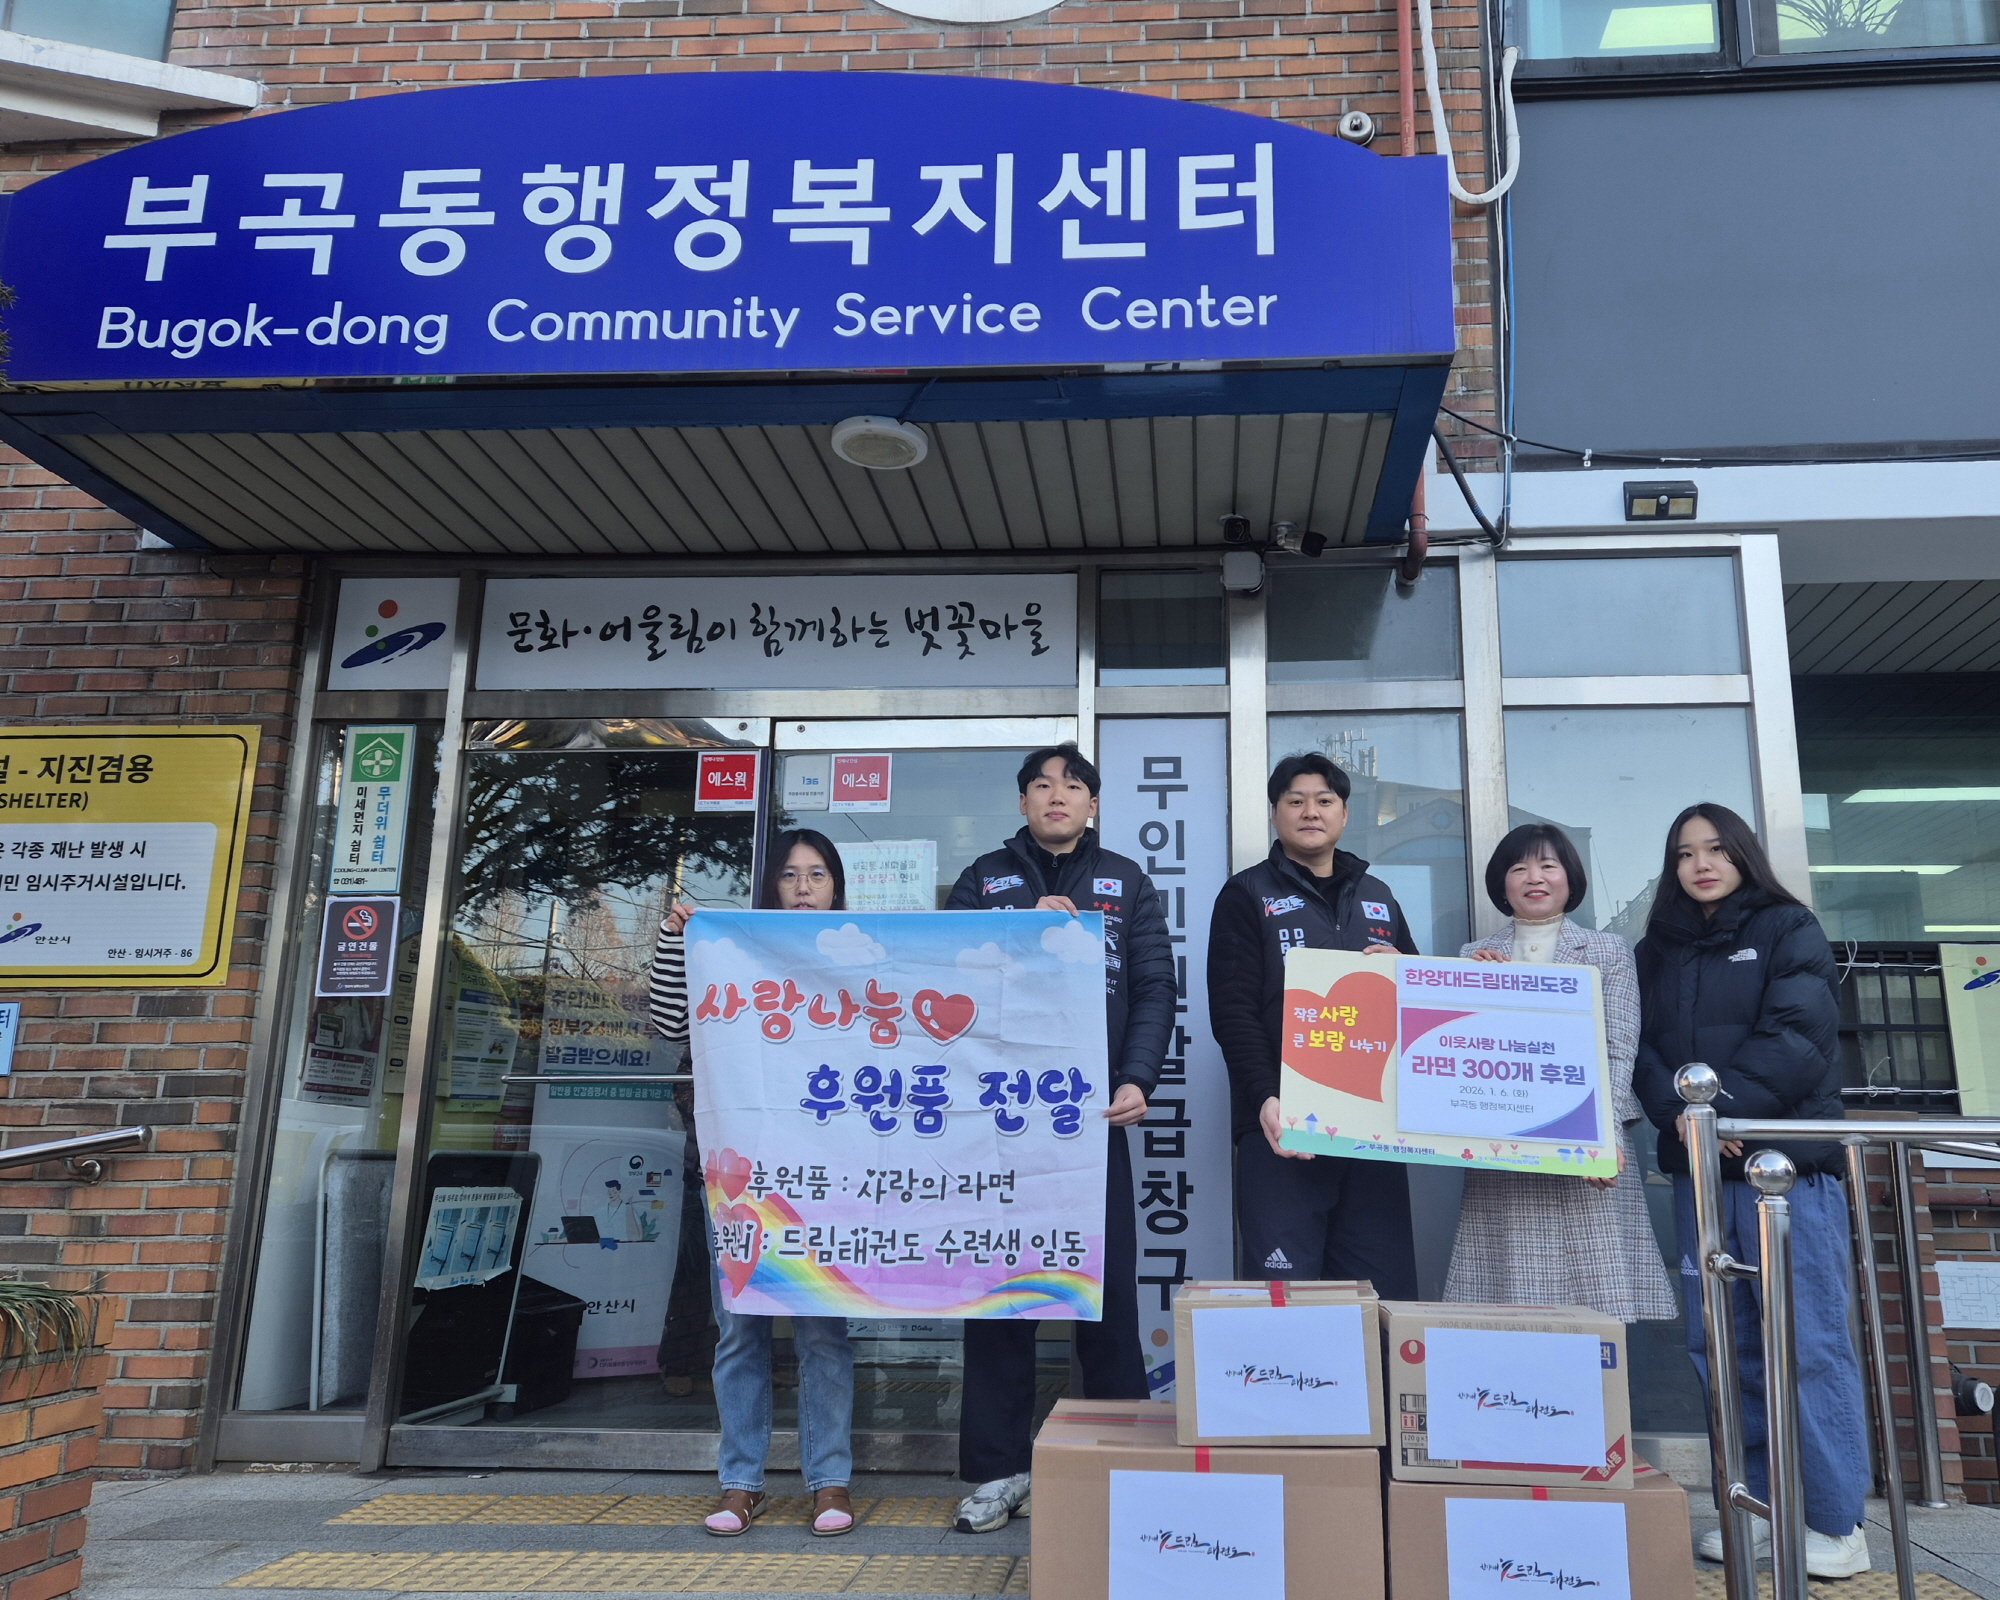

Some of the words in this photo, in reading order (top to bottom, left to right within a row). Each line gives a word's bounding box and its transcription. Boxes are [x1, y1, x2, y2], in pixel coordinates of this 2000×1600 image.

[103, 143, 1275, 281] 부곡동행정복지센터
[97, 301, 449, 359] Bugok-dong
[487, 296, 800, 348] Community
[833, 292, 1041, 338] Service
[1081, 285, 1278, 332] Center
[750, 602, 890, 657] 함께하는
[37, 754, 154, 784] 지진겸용
[708, 771, 747, 787] 에스원
[842, 773, 880, 788] 에스원
[352, 786, 367, 836] 미세먼지
[374, 786, 391, 831] 무더위
[11, 840, 44, 859] 각종
[50, 841, 84, 859] 재난
[91, 841, 124, 858] 발생
[130, 841, 146, 858] 시
[349, 840, 361, 865] 쉼터
[371, 835, 386, 865] 쉼터
[26, 873, 186, 892] 임시주거시설입니다.
[35, 936, 71, 945] 안산시
[337, 942, 378, 952] 금연건물
[108, 949, 126, 959] 안산
[135, 949, 172, 959] 임시거주
[180, 949, 192, 958] 86
[1405, 968, 1578, 994] 한양대드림태권도장
[696, 978, 903, 1050] 사랑나눔
[1293, 1006, 1318, 1023] 작은
[1319, 1006, 1358, 1028] 사랑
[1292, 1032, 1305, 1049] 큰
[1308, 1030, 1346, 1053] 보람
[1349, 1039, 1387, 1054] 나누기
[1439, 1035, 1496, 1052] 이웃사랑
[1499, 1038, 1556, 1055] 나눔실천
[545, 1046, 650, 1067] 발급받으세요!
[1412, 1055, 1457, 1078] 라면
[1462, 1059, 1534, 1083] 300개
[1540, 1062, 1586, 1086] 후원
[550, 1085, 571, 1096] 일반용
[573, 1086, 608, 1097] 인감증명서
[799, 1063, 951, 1136] 후원품
[978, 1066, 1094, 1139] 전달
[1459, 1086, 1486, 1095] 2026.
[1513, 1089, 1529, 1098] (화)
[1450, 1099, 1477, 1110] 부곡동
[1479, 1102, 1534, 1114] 행정복지센터
[1369, 1143, 1389, 1152] 부곡동
[1392, 1146, 1436, 1156] 행정복지센터
[748, 1161, 832, 1200] 후원품
[857, 1168, 946, 1205] 사랑의
[957, 1169, 1016, 1204] 라면
[778, 1225, 926, 1266] 드림태권도
[935, 1230, 1022, 1267] 수련생
[1030, 1229, 1087, 1267] 일동
[1264, 1261, 1293, 1269] adidas
[586, 1299, 635, 1315] 안산시
[1563, 1325, 1583, 1335] 1792
